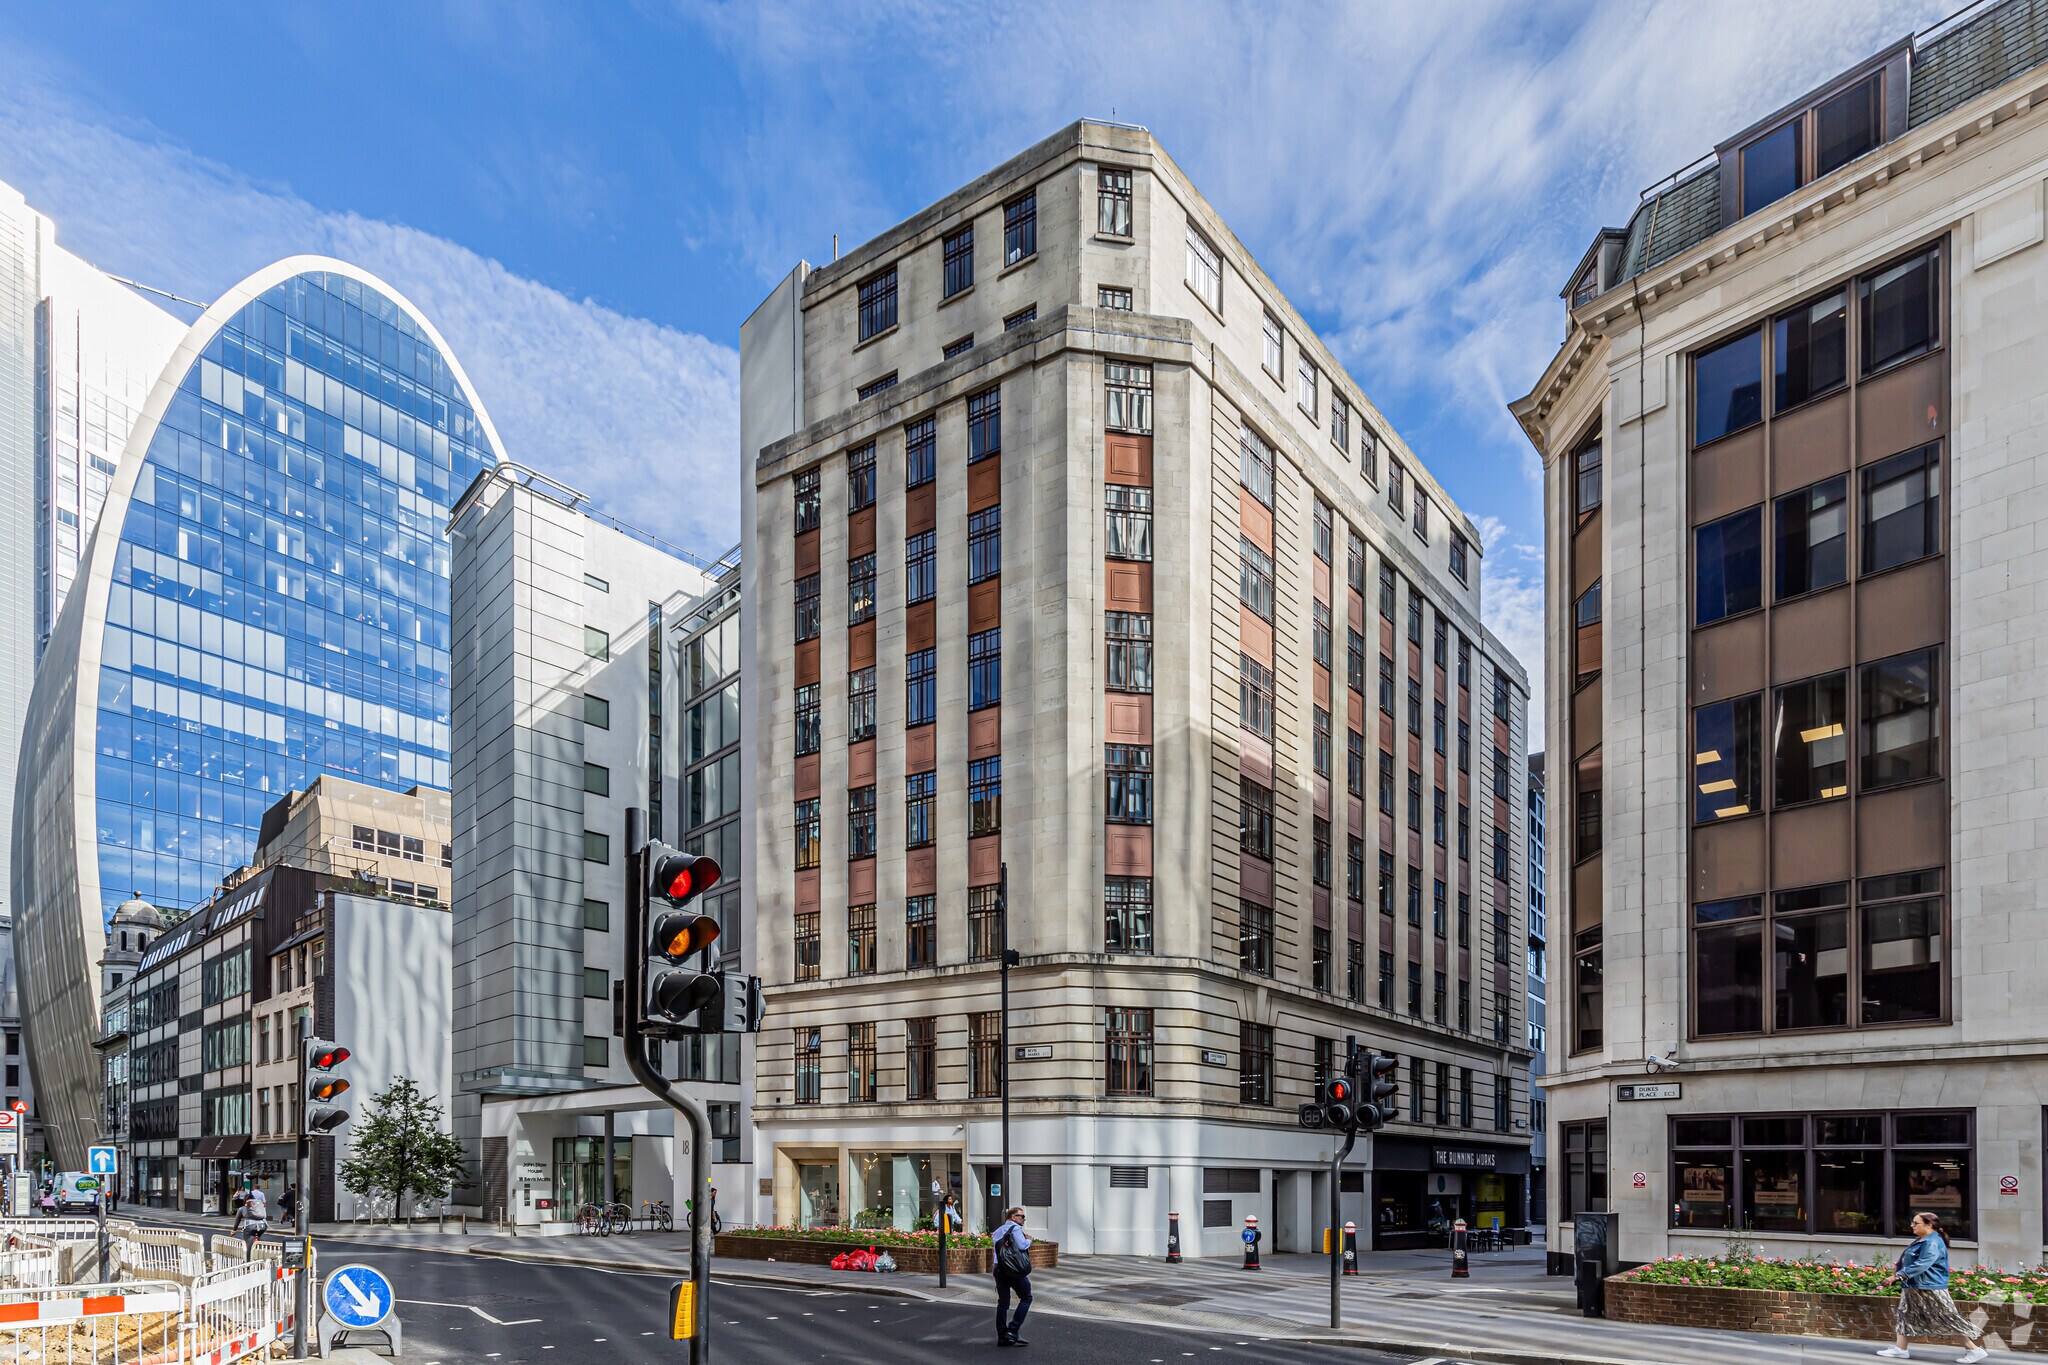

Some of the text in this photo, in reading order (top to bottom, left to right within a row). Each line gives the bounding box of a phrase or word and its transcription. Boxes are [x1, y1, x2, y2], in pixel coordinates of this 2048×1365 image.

[15, 1100, 27, 1111] A
[682, 1139, 690, 1155] 18
[1435, 1150, 1496, 1166] THE RUNNING WORKS
